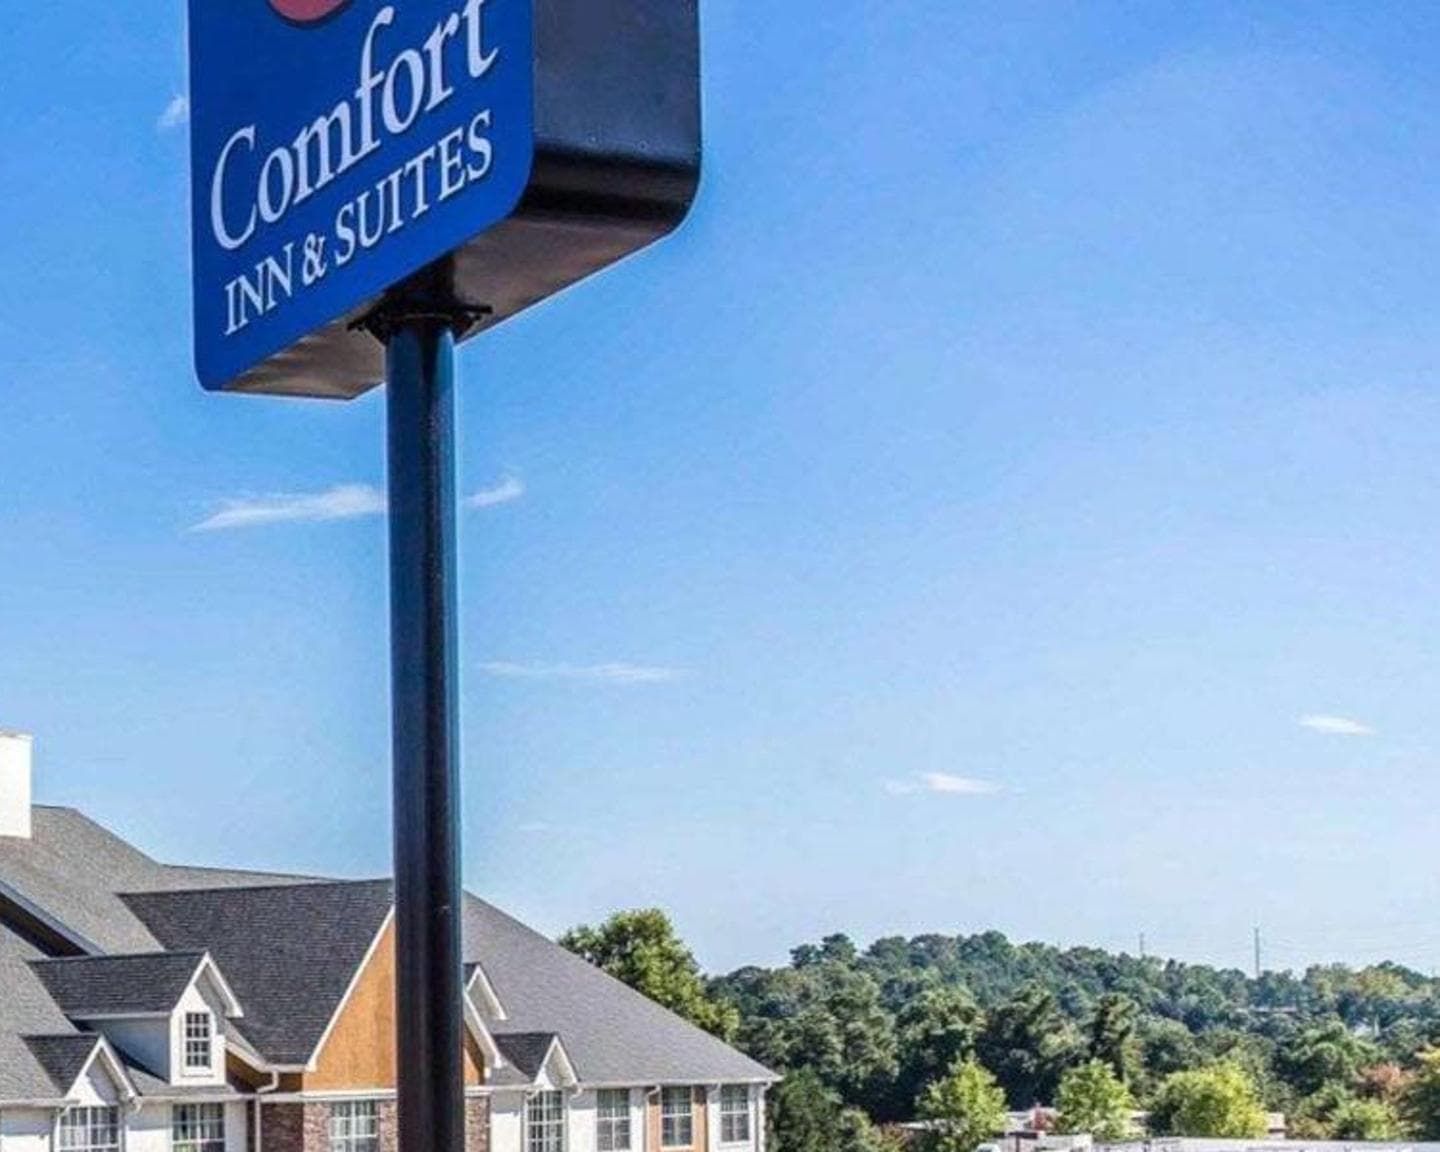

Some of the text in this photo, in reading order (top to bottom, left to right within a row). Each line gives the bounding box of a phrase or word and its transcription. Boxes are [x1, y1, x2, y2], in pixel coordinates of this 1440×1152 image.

[211, 0, 498, 250] Comfort
[224, 109, 492, 336] INN & SUITES
